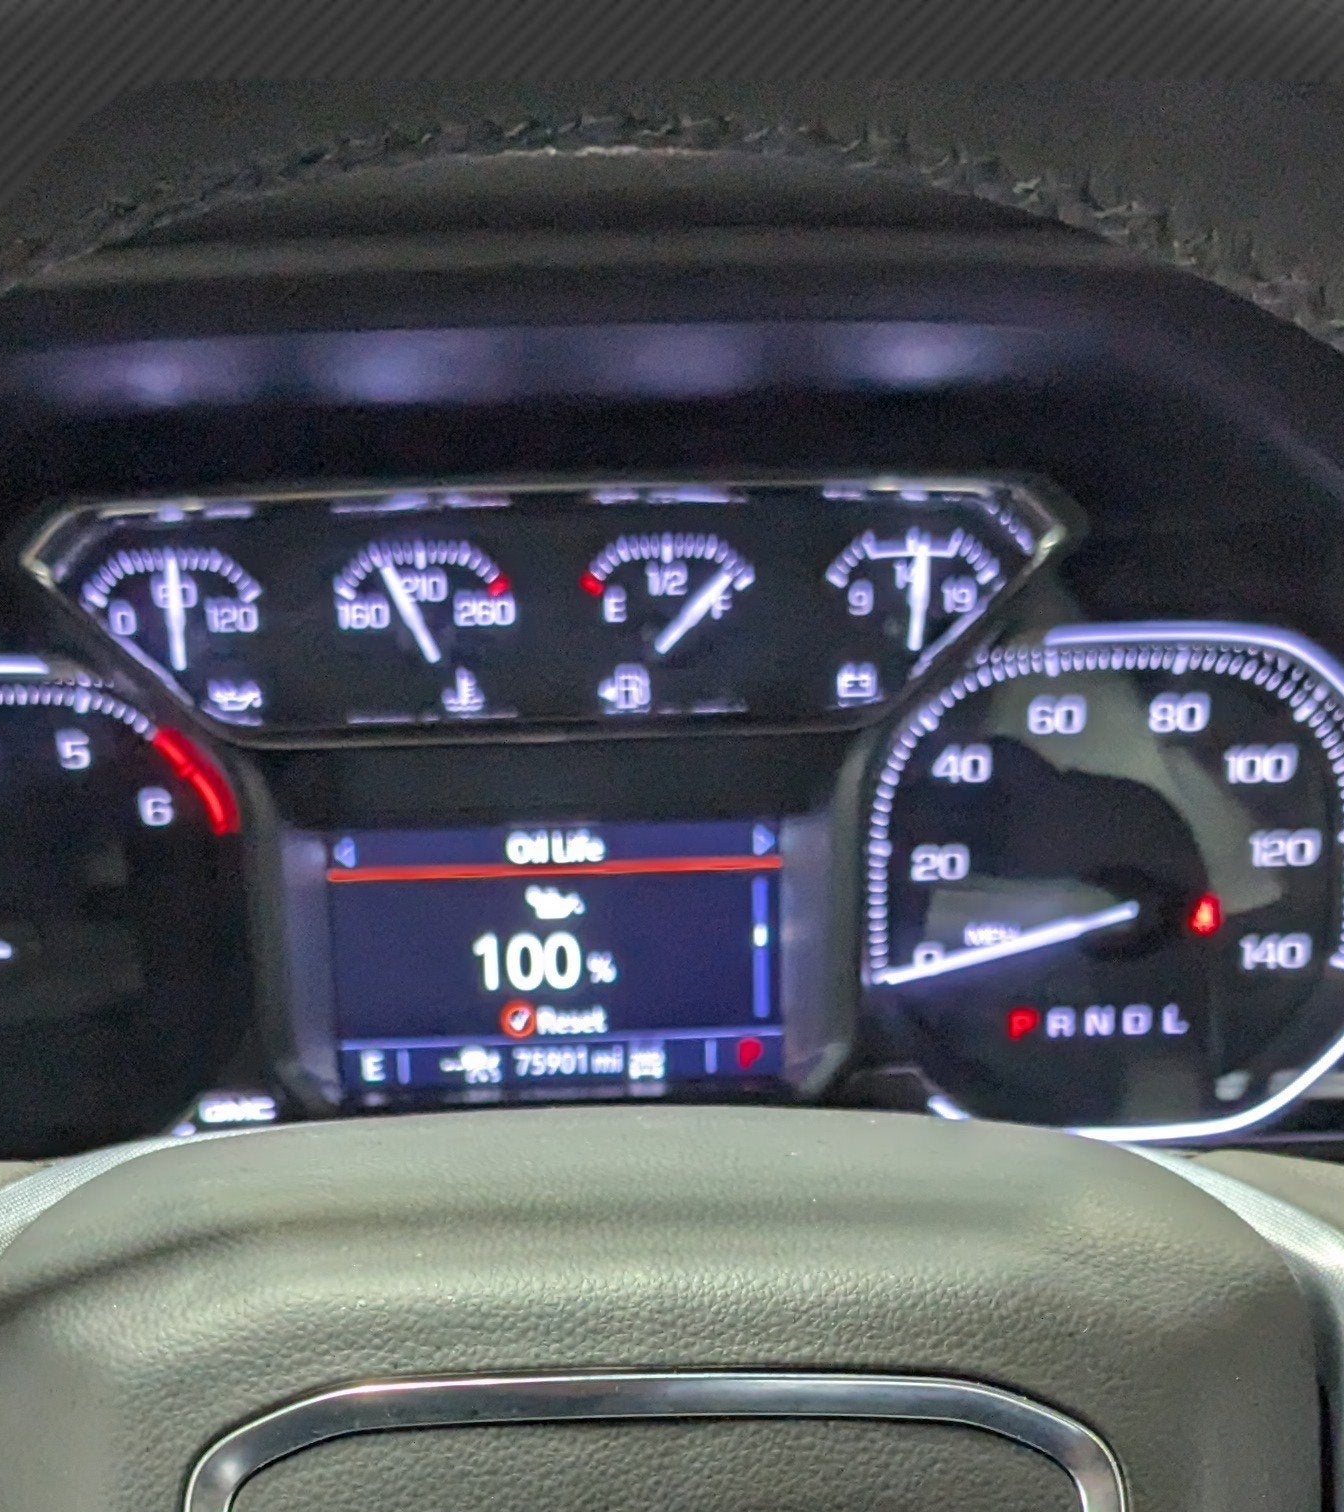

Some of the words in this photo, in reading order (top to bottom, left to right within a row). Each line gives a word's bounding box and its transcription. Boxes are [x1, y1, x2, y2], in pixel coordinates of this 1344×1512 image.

[455, 593, 517, 626] 260
[603, 585, 628, 623] E
[848, 578, 874, 616] 9
[941, 575, 978, 614] 19
[109, 601, 137, 636] 0
[205, 600, 259, 634] 120
[336, 598, 391, 630] 160
[1027, 695, 1087, 734] 60
[1148, 693, 1210, 733] 80
[57, 728, 91, 771] 5
[930, 744, 993, 784] 40
[1223, 743, 1298, 784] 100
[137, 786, 174, 827] 6
[506, 830, 550, 864] Oil
[552, 829, 607, 863] Life
[909, 844, 970, 882] 20
[1250, 829, 1322, 868] 120
[472, 931, 582, 992] 100
[1239, 934, 1313, 971] 140
[535, 1006, 609, 1035] Reset
[1008, 1006, 1040, 1042] P
[1046, 1004, 1074, 1039] R
[1084, 1004, 1115, 1038] N
[1122, 1004, 1152, 1037] D
[1162, 1003, 1189, 1035] L
[361, 1050, 386, 1083] E
